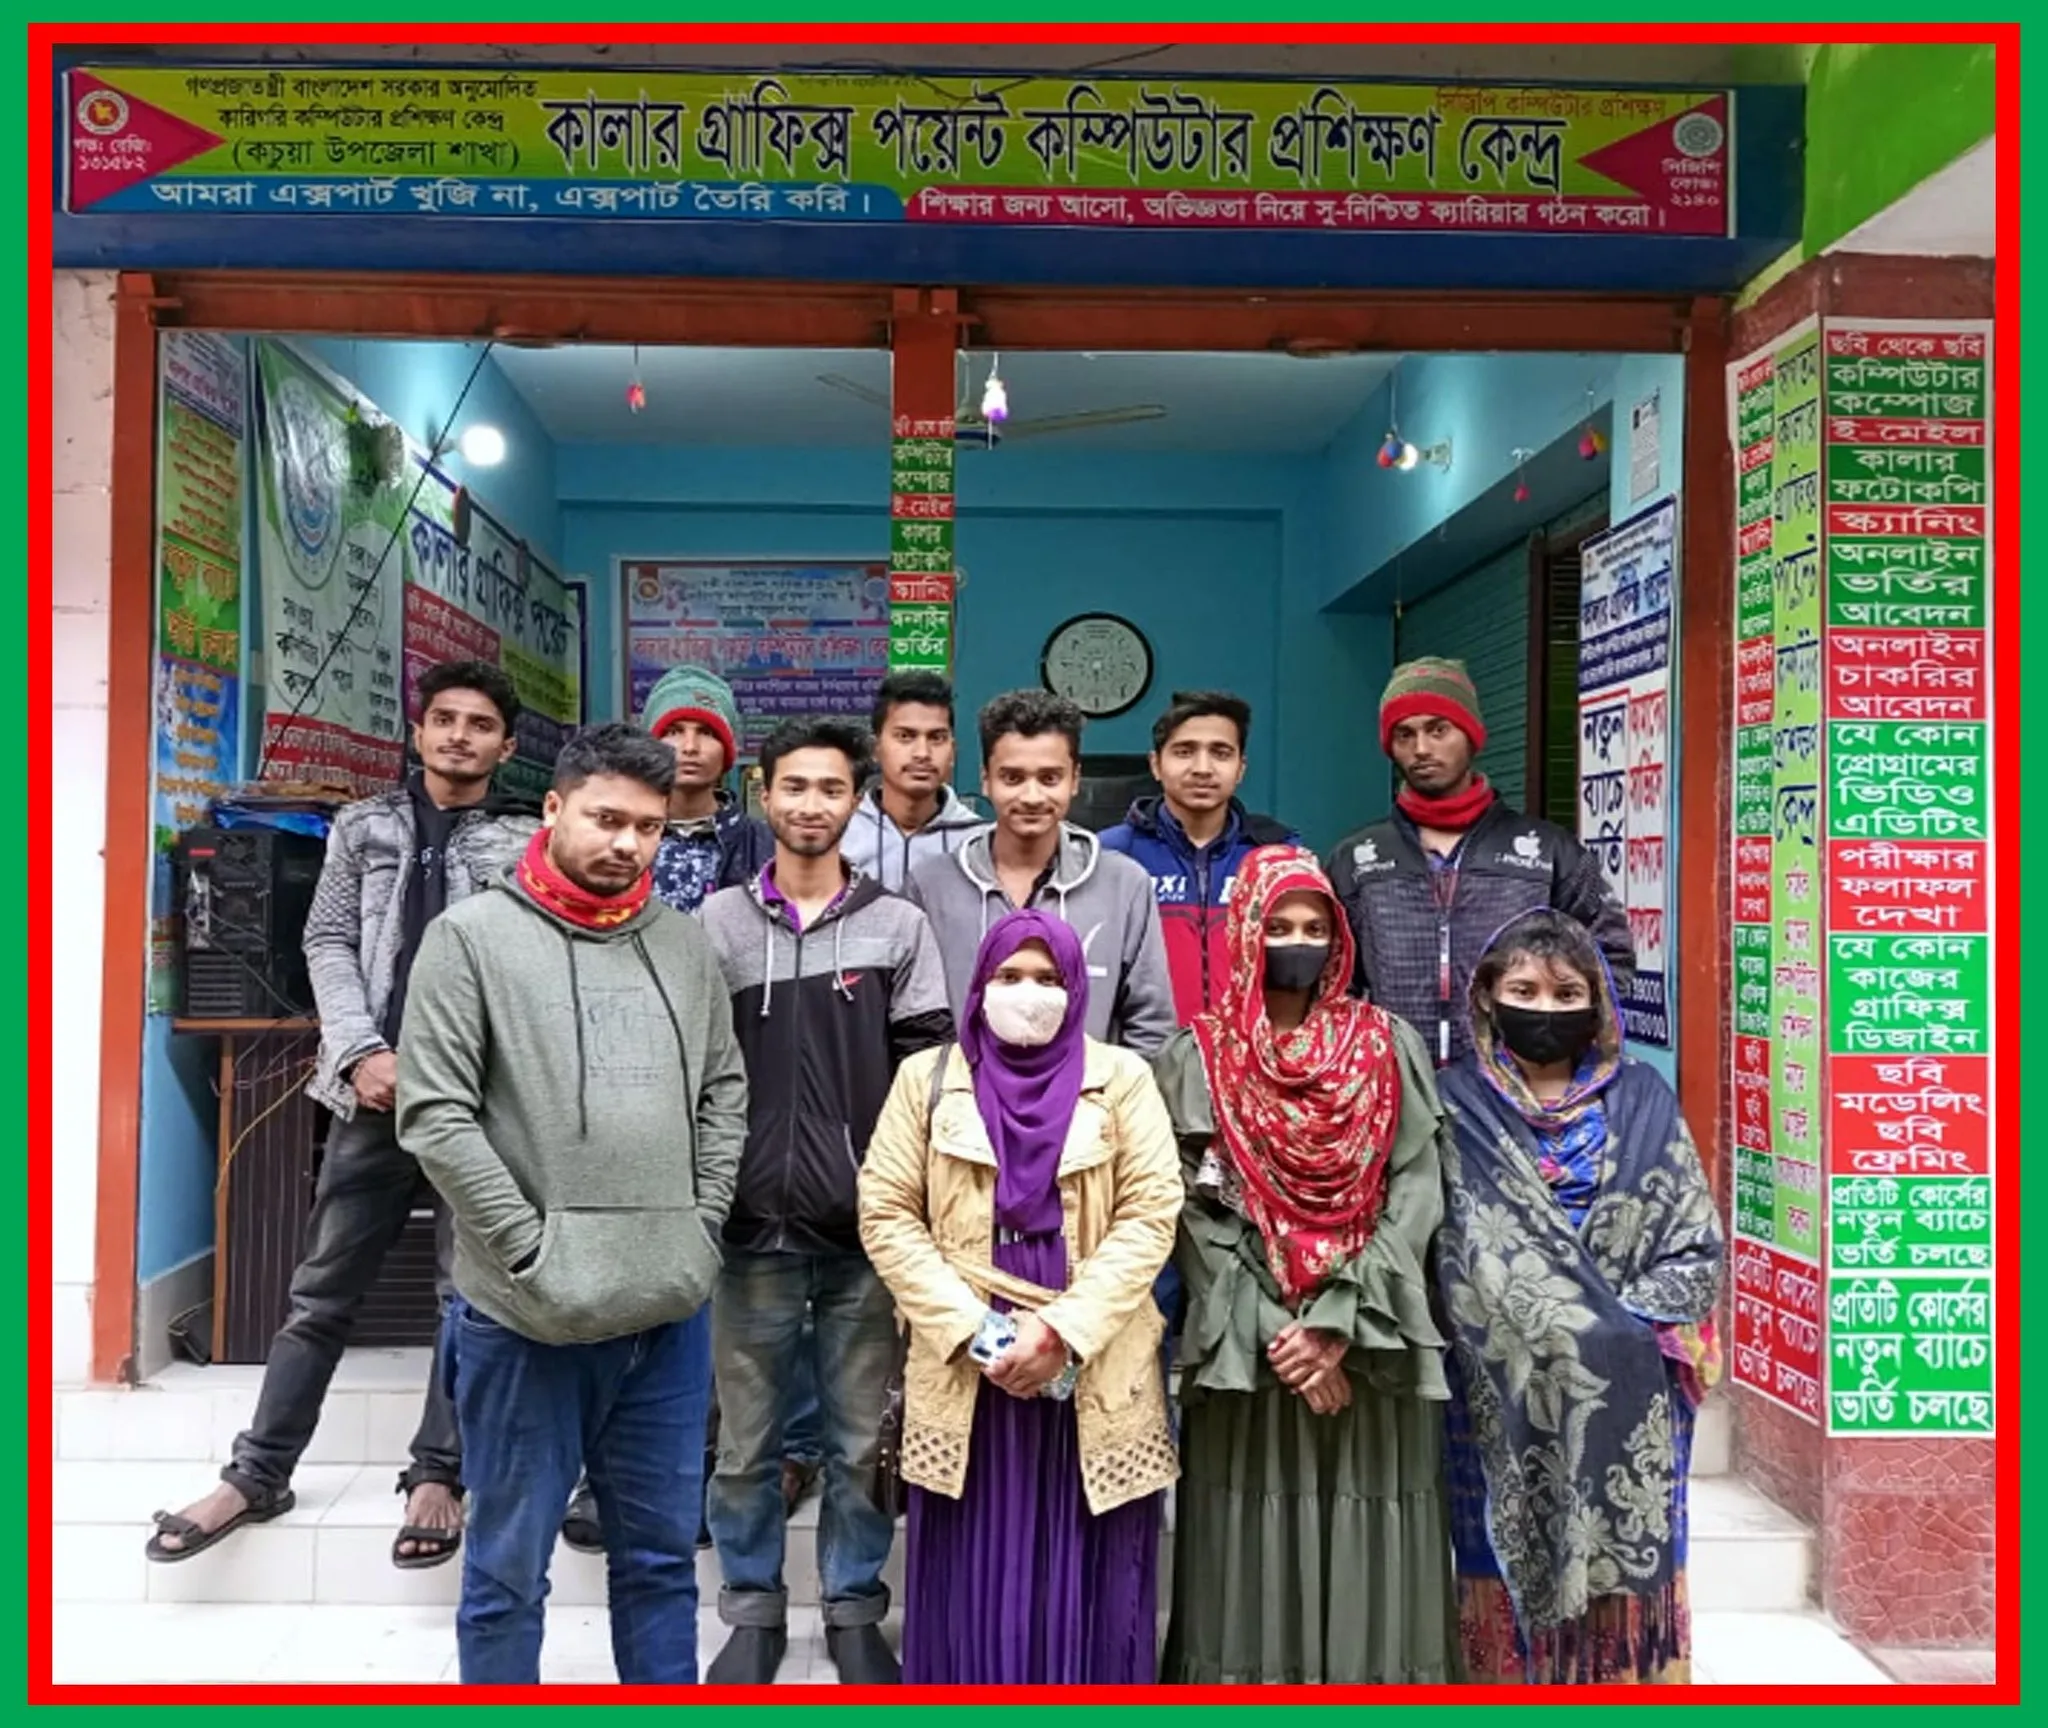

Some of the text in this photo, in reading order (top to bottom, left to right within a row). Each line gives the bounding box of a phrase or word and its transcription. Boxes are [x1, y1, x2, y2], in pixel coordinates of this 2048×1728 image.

[293, 76, 373, 97] বাংলাদেশ
[381, 77, 440, 98] সরকার
[447, 75, 538, 101] অনুমোদিত
[219, 105, 504, 131] কারিগরি কম্পিউটার প্রশিক্ষণ কেন্দ্র
[325, 135, 435, 165] উপজেলা
[542, 76, 1569, 195] কালার গ্রাফিক্স পয়েন্ট কম্পিউটার প্রশিক্ষণ কেন্দ্র
[151, 181, 256, 207] আমরা
[269, 176, 398, 211] এক্সপার্ট
[556, 180, 680, 214] এক্সপার্ট
[693, 182, 773, 213] তৈরি
[786, 183, 851, 213] করি
[919, 187, 993, 218] শিক্ষার
[1003, 193, 1050, 219] জন্য
[1142, 191, 1248, 223] অভিজ্ঞতা
[1255, 192, 1305, 221] নিয়ে
[1430, 195, 1529, 226] ক্যারিয়ার
[1538, 196, 1587, 227] গঠন
[1594, 201, 1651, 227] করো
[1829, 332, 1983, 357] ছবি থেকে ছবি
[1829, 357, 1982, 389] কম্পিউটার
[1829, 390, 1979, 416] কম্পোজ
[1852, 448, 1960, 474] কালার
[1831, 474, 1984, 503] ফটোকপি
[1832, 506, 1981, 535] স্ক্যানিং
[1831, 539, 1982, 568] অনলাইন
[1836, 567, 1977, 597] ভর্তির
[1837, 600, 1976, 626] আবেদন
[1831, 630, 1982, 660] অনলাইন
[1833, 659, 1981, 688] চাকরির
[1837, 693, 1976, 718] আবেদন
[1583, 704, 1627, 764] নতুন
[1832, 722, 1981, 747] যে কোন
[1832, 752, 1980, 779] প্রোগ্রামের
[1582, 769, 1626, 817] ব্যাচে
[1834, 776, 1976, 806] ভিডিও
[1834, 806, 1985, 838] এডিটিং
[1584, 818, 1624, 876] র্তি
[1837, 841, 1981, 871] পরীক্ষার
[1836, 876, 1979, 900] ফলাফল
[1851, 903, 1964, 928] দেখা
[1831, 935, 1977, 961] যে কোন
[1842, 966, 1963, 991] কাজের
[1850, 990, 1971, 1023] গ্রাফিক্স
[1842, 1020, 1982, 1052] ডিজাইন
[1872, 1056, 1948, 1088] ছবি
[1835, 1085, 1987, 1115] মডেলিং
[1872, 1114, 1949, 1145] ছবি
[1848, 1143, 1975, 1173] ফ্রেমিং
[1831, 1177, 1989, 1208] প্রতিটি কোর্সের
[1832, 1209, 1906, 1240] নতুন
[1912, 1209, 1990, 1232] ব্যাচে
[1832, 1236, 1991, 1269] ভর্তি চলছে
[1831, 1277, 1989, 1329] প্রতিটি কোর্সের
[1832, 1331, 1990, 1380] নতুন ব্যাচে
[1832, 1375, 1994, 1431] ভর্তি চলছে
